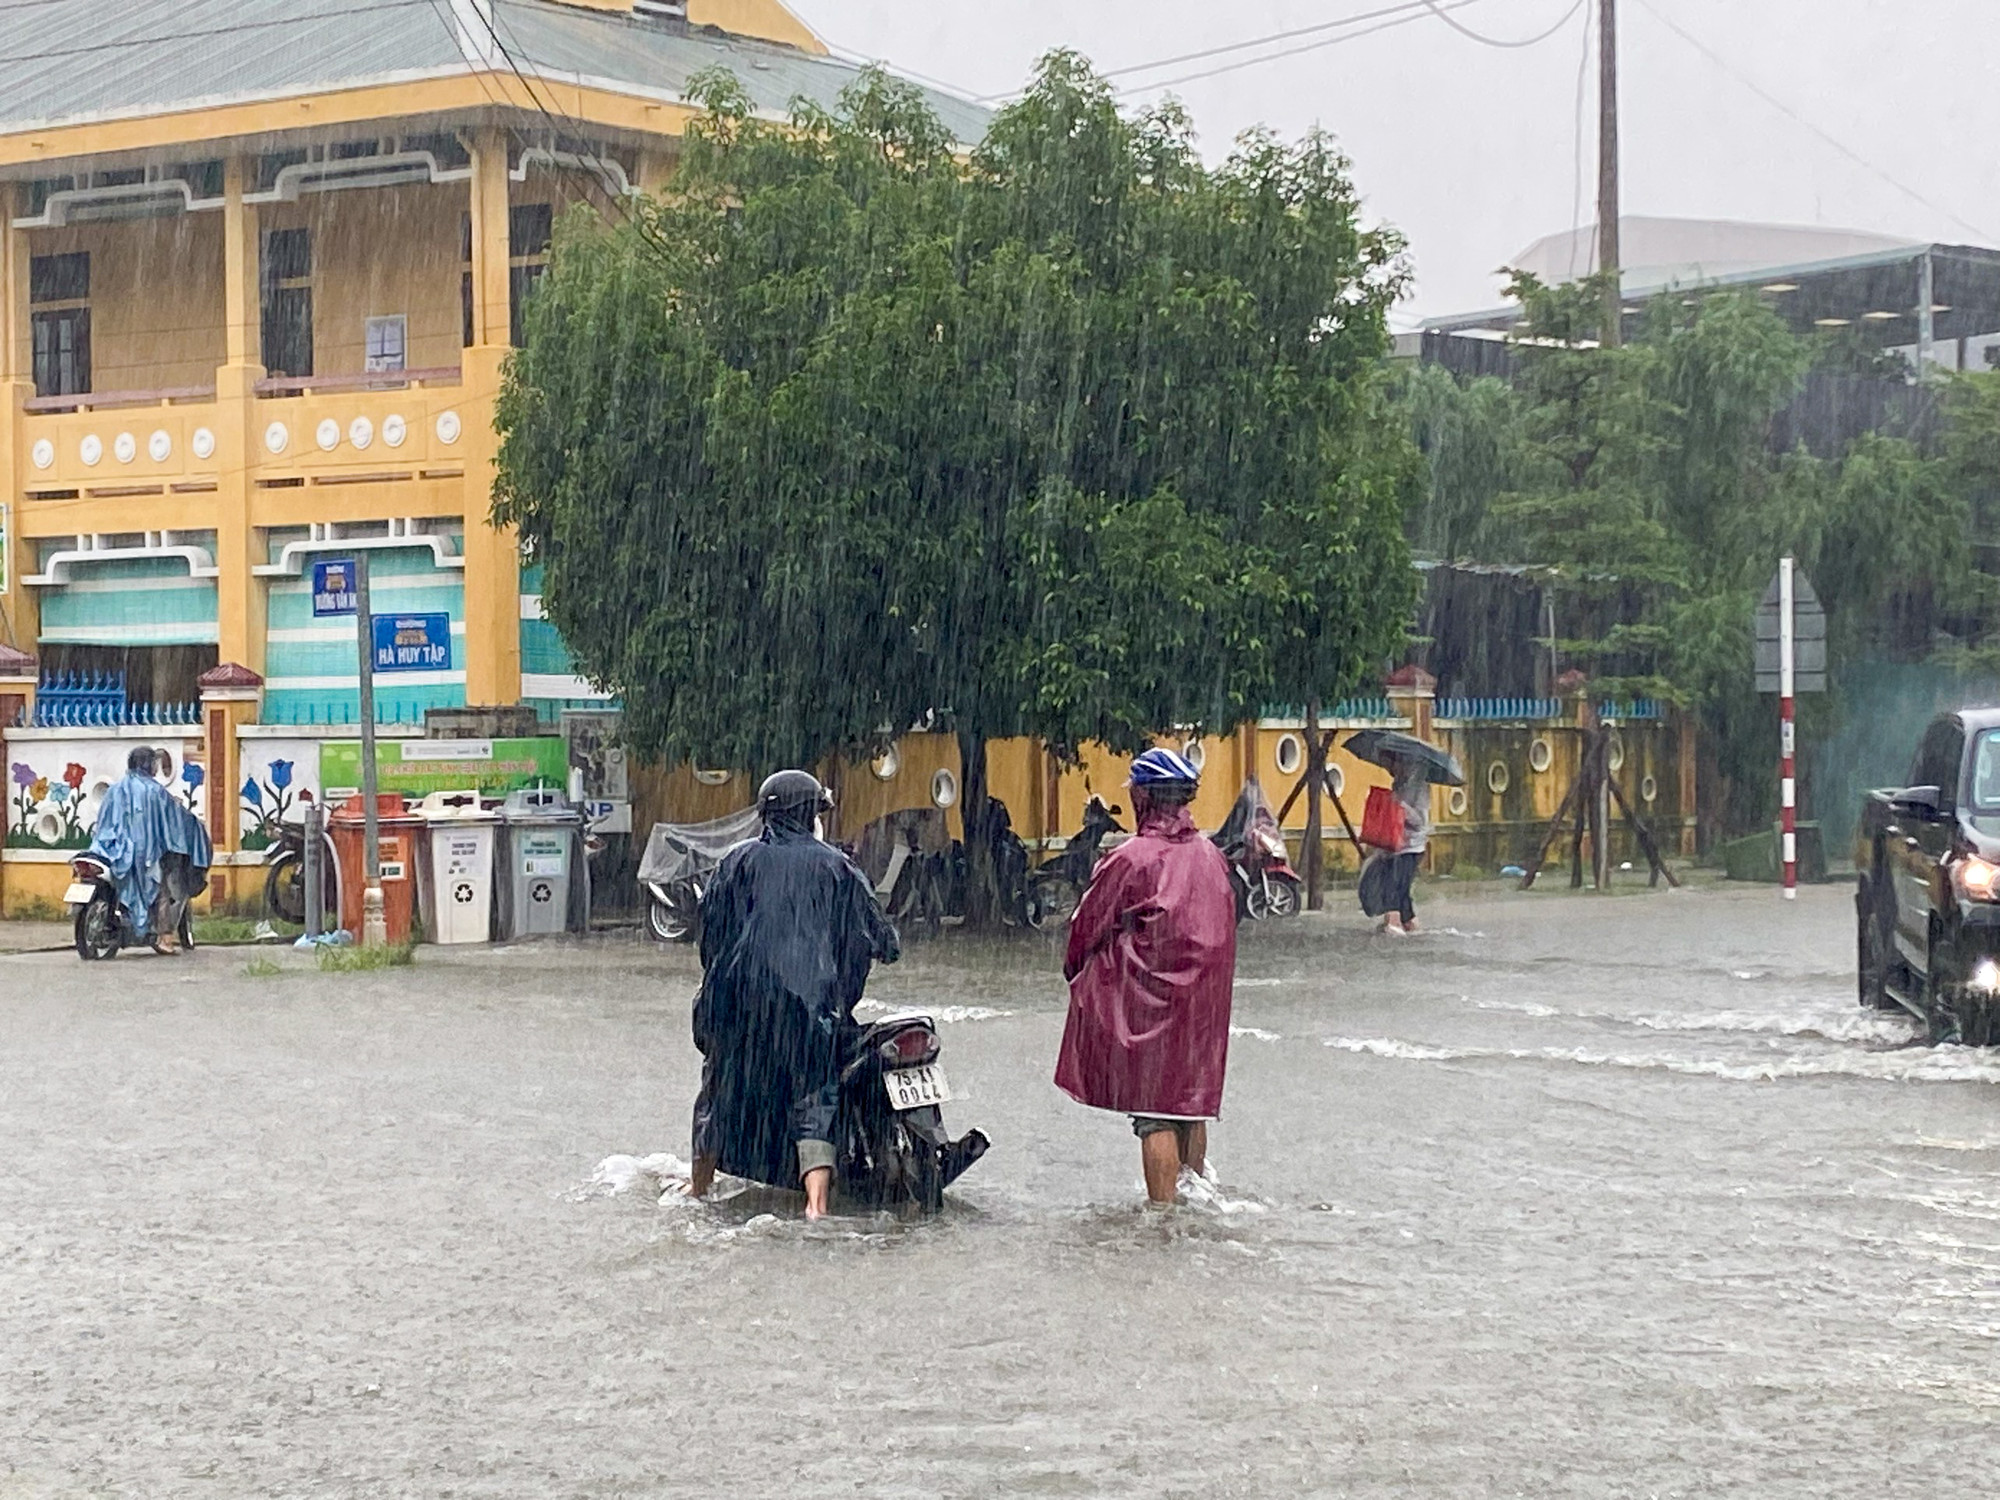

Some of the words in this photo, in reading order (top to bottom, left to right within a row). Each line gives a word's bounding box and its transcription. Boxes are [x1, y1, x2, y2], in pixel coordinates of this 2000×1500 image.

[378, 643, 395, 665] HÀ
[397, 646, 421, 664] HUY
[422, 643, 446, 667] TẬP
